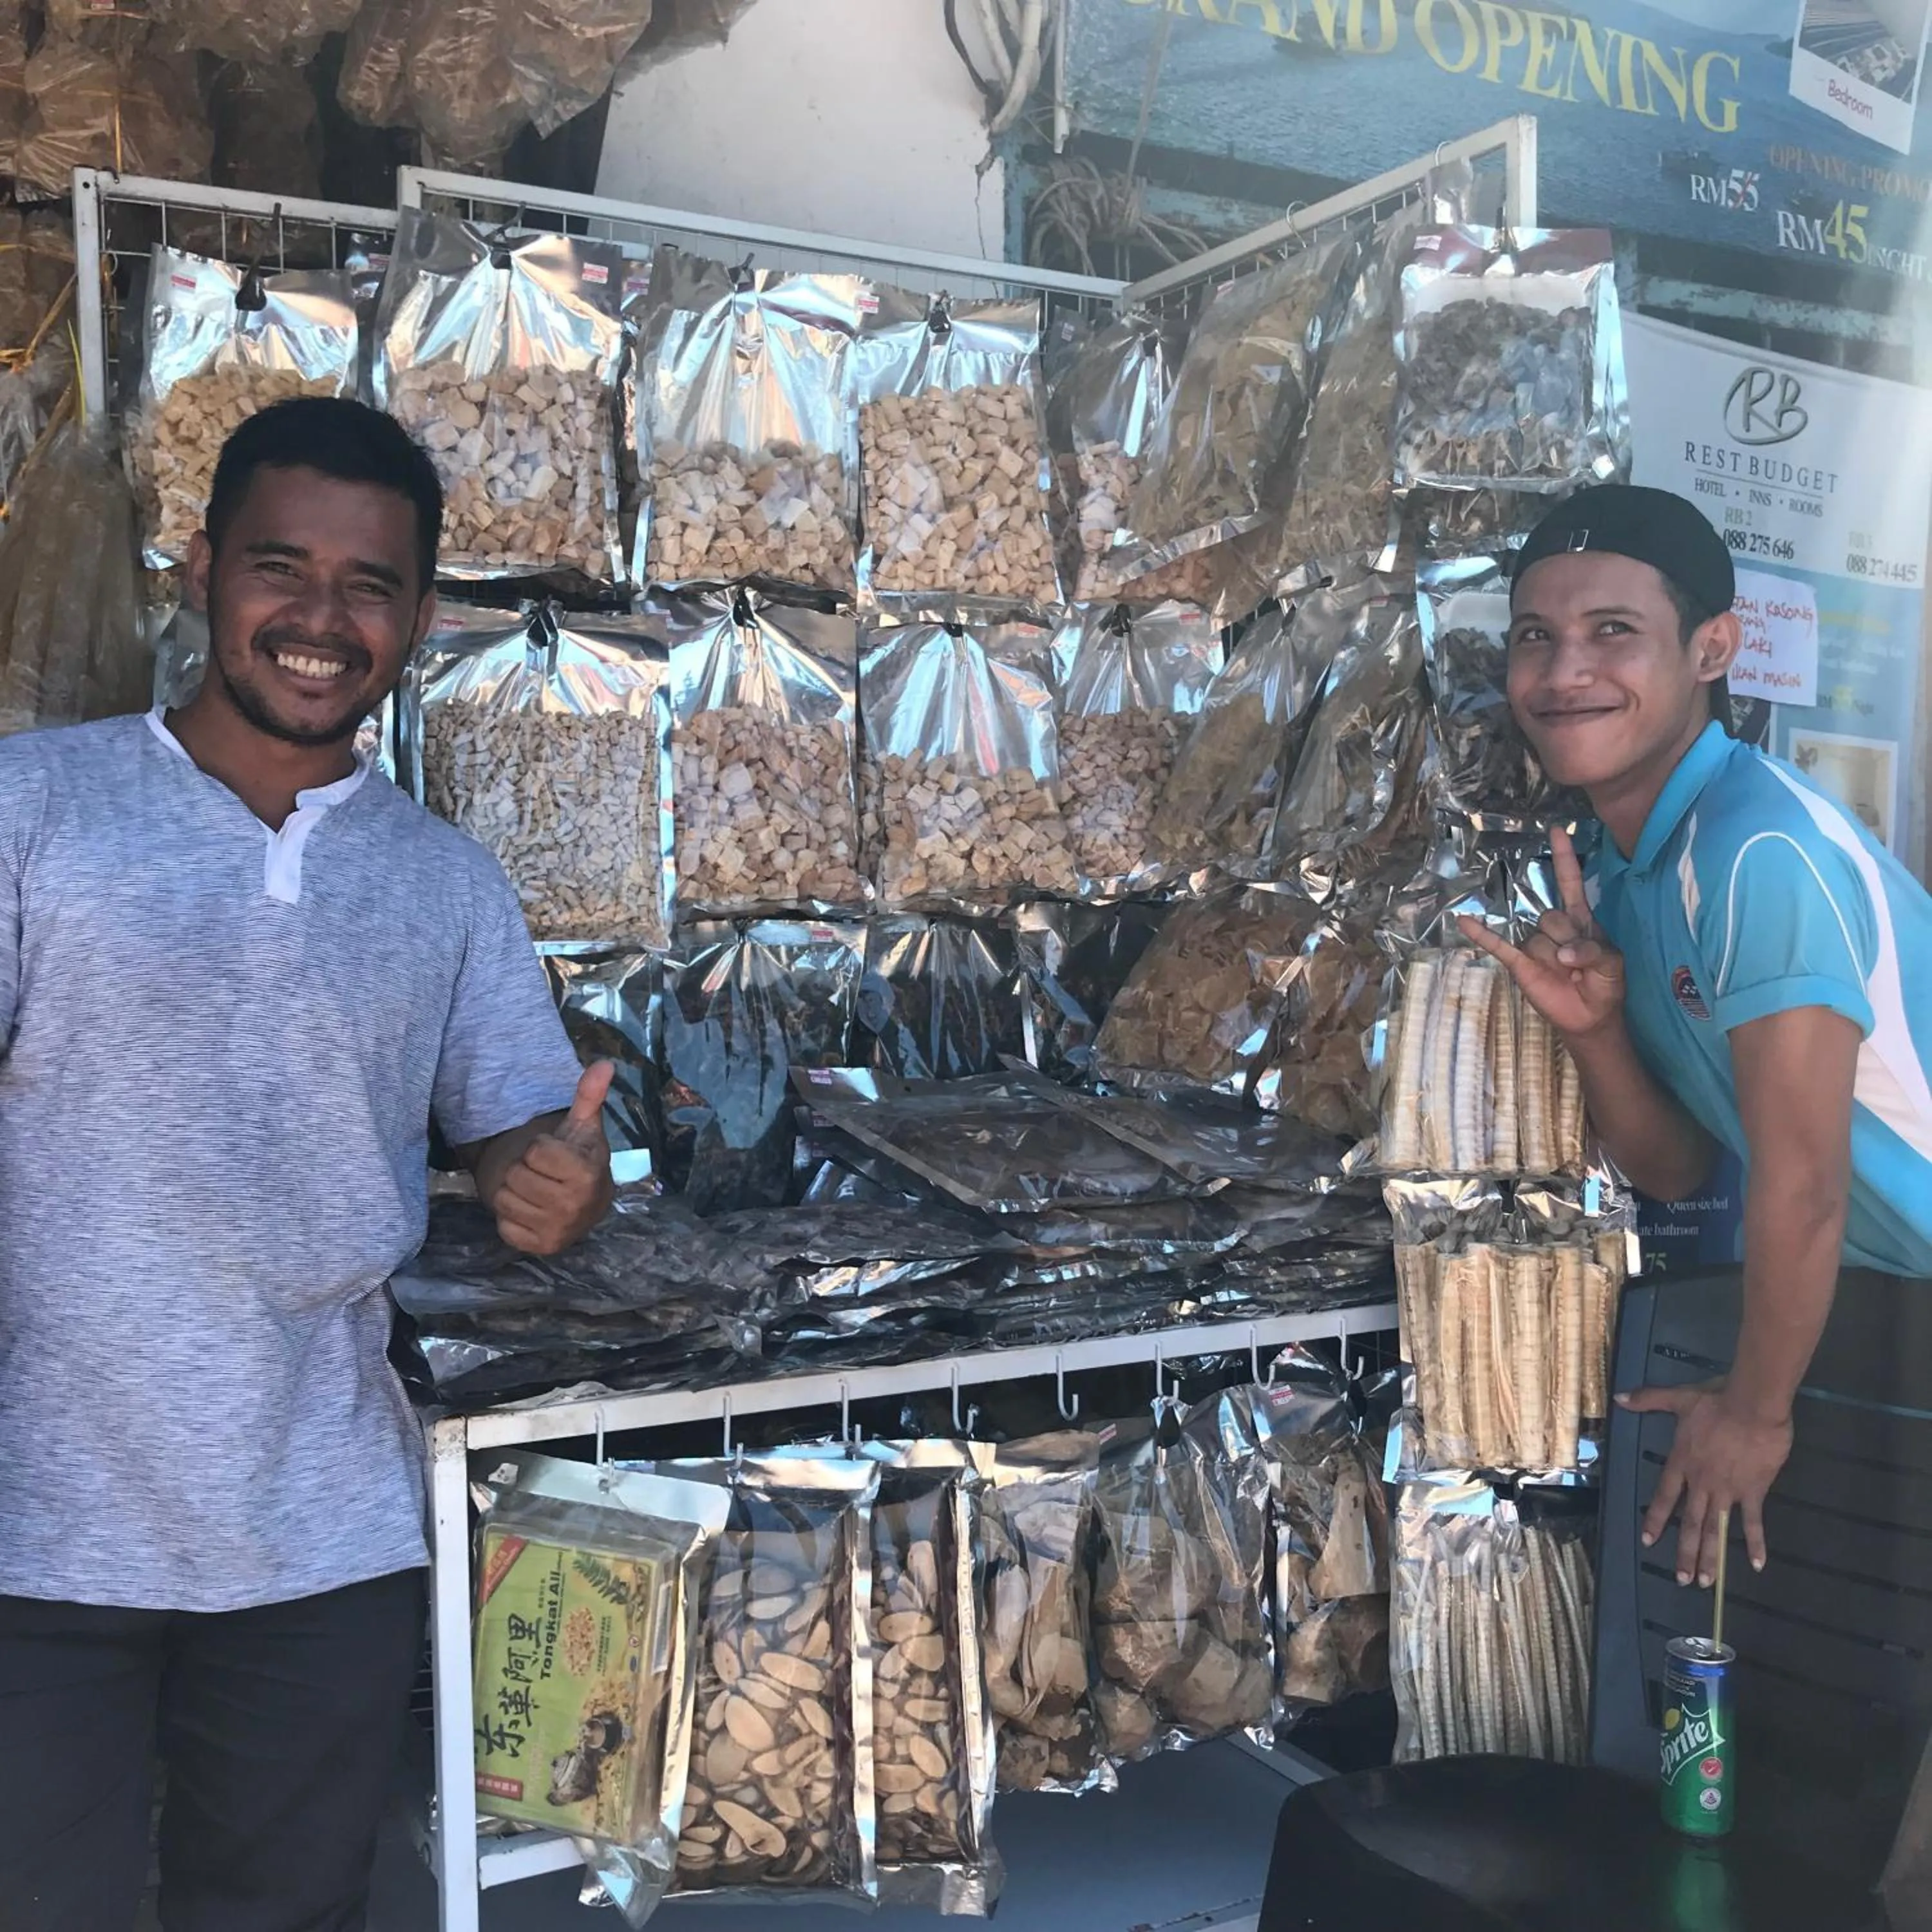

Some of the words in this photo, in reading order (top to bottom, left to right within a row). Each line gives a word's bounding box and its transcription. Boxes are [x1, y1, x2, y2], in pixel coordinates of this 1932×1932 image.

[1414, 0, 1741, 133] OPENING
[1827, 79, 1873, 120] Bedroom
[1684, 441, 1741, 473] REST
[1748, 455, 1839, 493] BUDGET
[1694, 477, 1727, 497] HOTEL
[1749, 488, 1772, 507] INNS
[1789, 498, 1824, 518] ROOMS
[1723, 528, 1747, 551] 088
[1750, 533, 1770, 556] 275
[1772, 538, 1795, 560] 646
[540, 1600, 559, 1680] Tongkat
